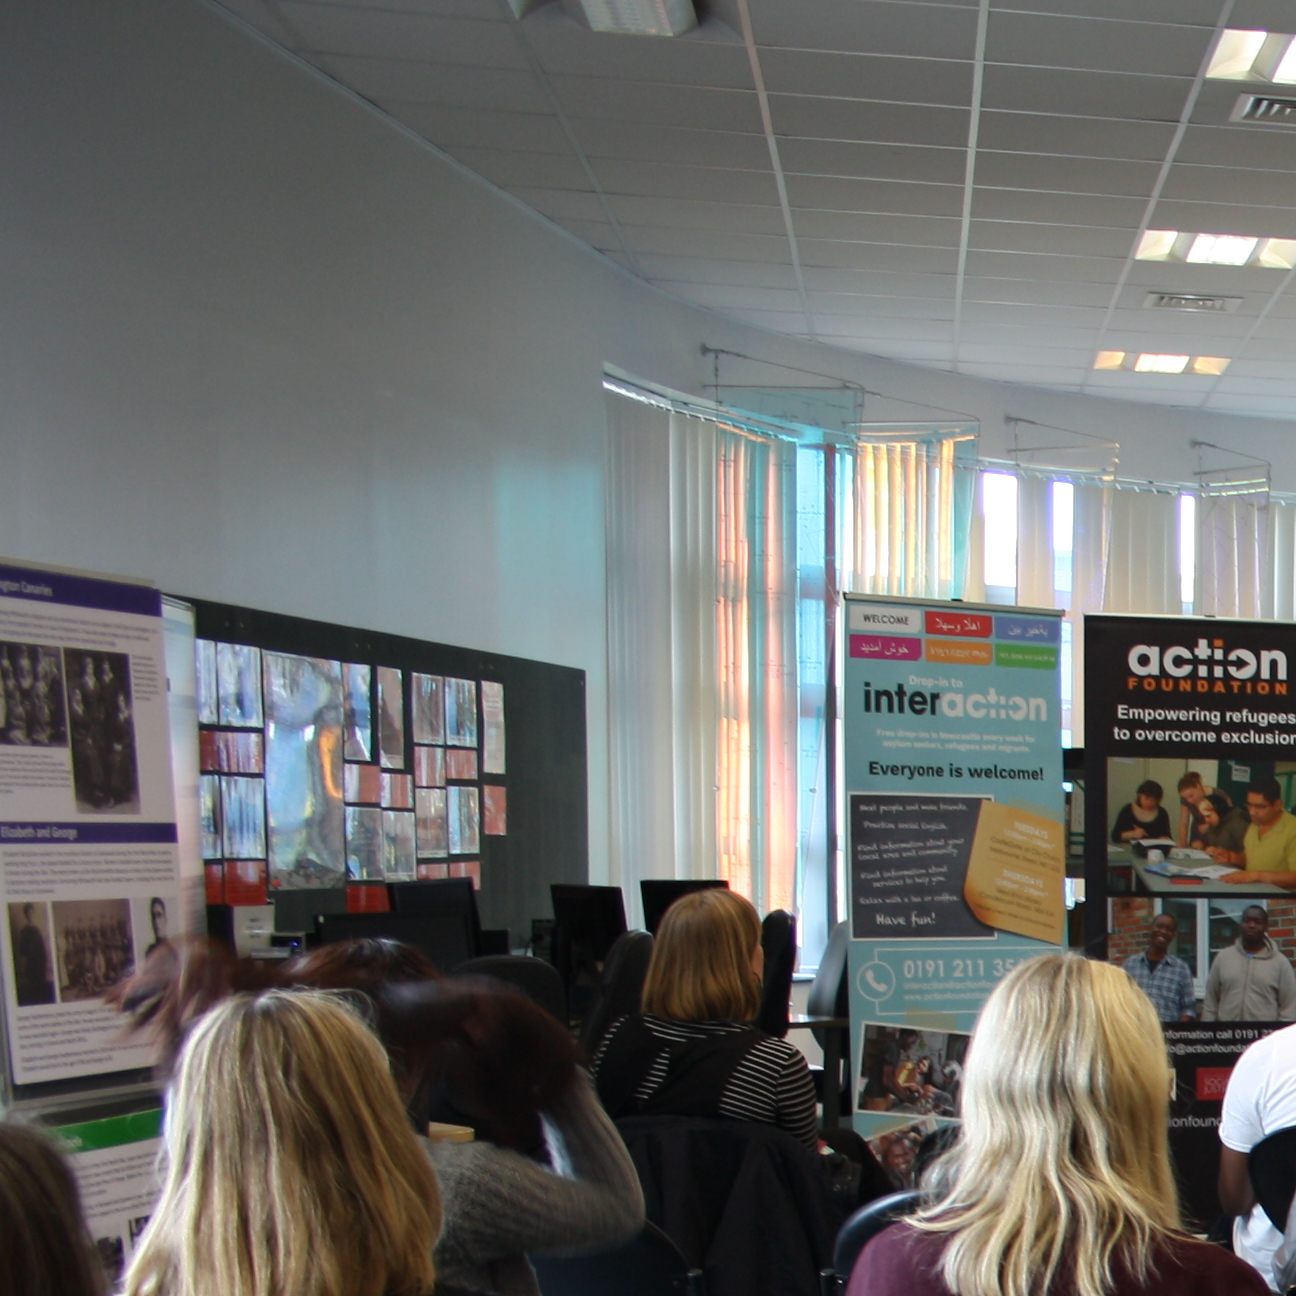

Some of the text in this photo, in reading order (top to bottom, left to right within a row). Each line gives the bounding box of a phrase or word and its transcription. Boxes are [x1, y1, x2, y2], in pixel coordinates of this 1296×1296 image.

[863, 613, 910, 626] WELCOME
[1127, 638, 1288, 681] action
[909, 675, 963, 688] Drop-in to
[1127, 677, 1288, 696] FOUNDATION
[863, 681, 1048, 721] interaction
[1117, 704, 1222, 726] Empowering
[1113, 726, 1131, 741] to
[1135, 728, 1217, 744] overcome
[869, 761, 1045, 781] Everyone is welcome!
[37, 826, 51, 839] and
[52, 826, 78, 841] George
[875, 910, 936, 928] Have fun!
[903, 959, 945, 978] 0191
[952, 959, 985, 978] 211
[1164, 1029, 1214, 1040] nformation
[1216, 1029, 1233, 1040] call
[1234, 1029, 1259, 1040] 0191
